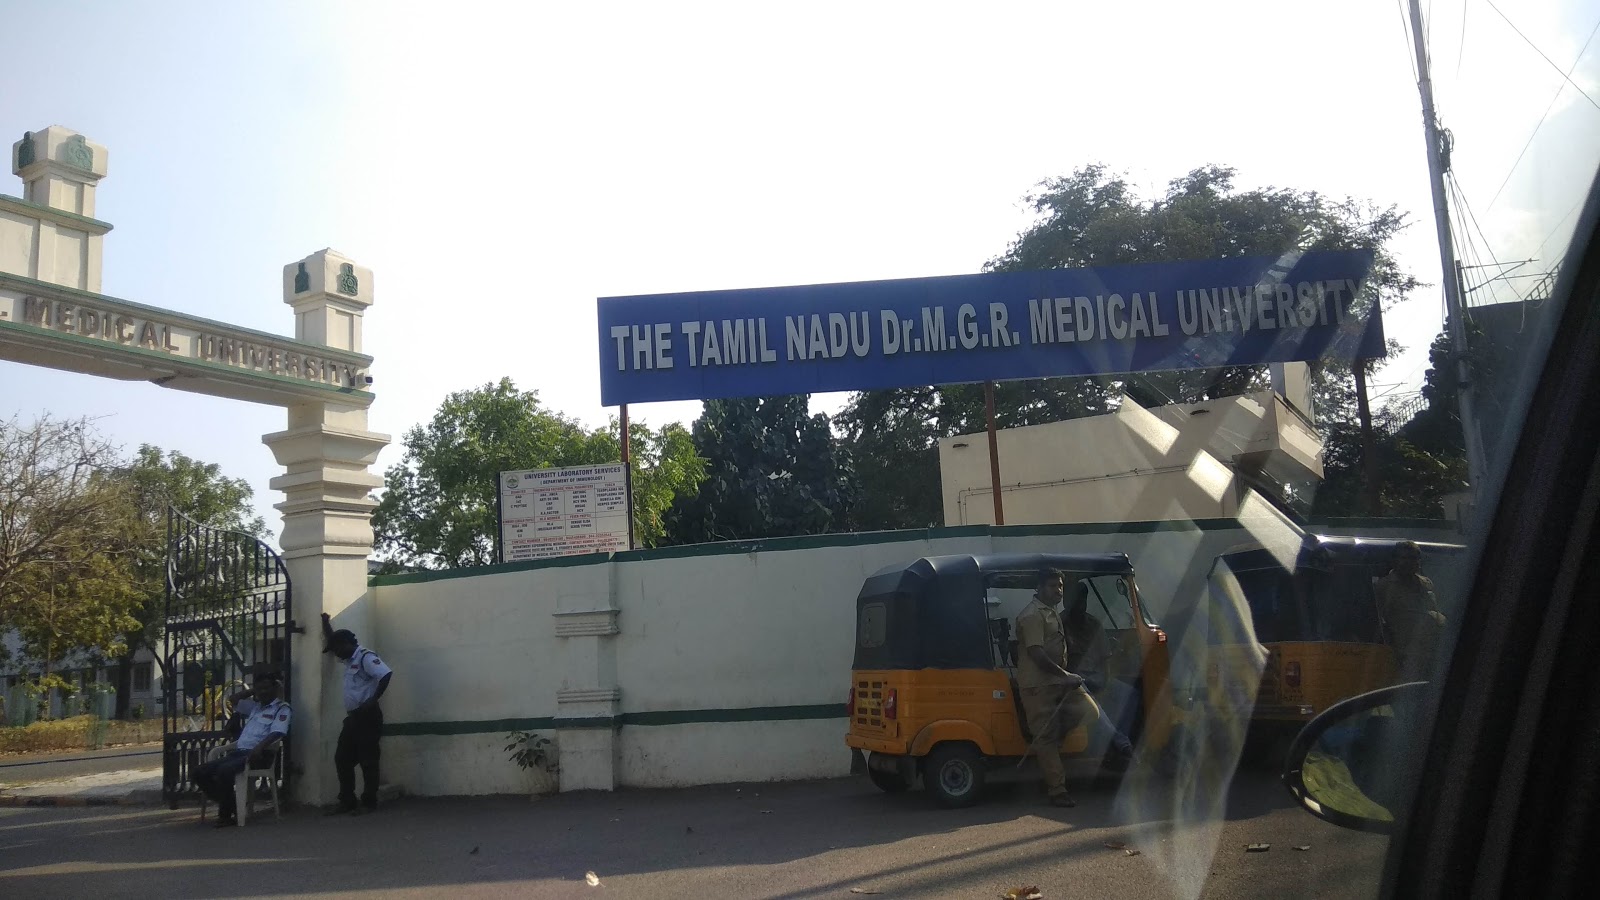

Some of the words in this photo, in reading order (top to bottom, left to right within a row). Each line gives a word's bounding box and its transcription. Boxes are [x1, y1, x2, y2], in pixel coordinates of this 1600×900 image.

[23, 296, 179, 351] MEDICAL
[199, 333, 358, 386] UNIVERSITY
[611, 323, 674, 371] THE
[682, 317, 776, 367] TAMIL
[785, 311, 870, 361] NADU
[1028, 291, 1169, 344] MEDICAL
[524, 471, 556, 480] UNIVERSITY
[557, 468, 594, 477] LABORATORY
[594, 466, 621, 475] SERVICES
[576, 475, 603, 483] IMMUNOLOGY
